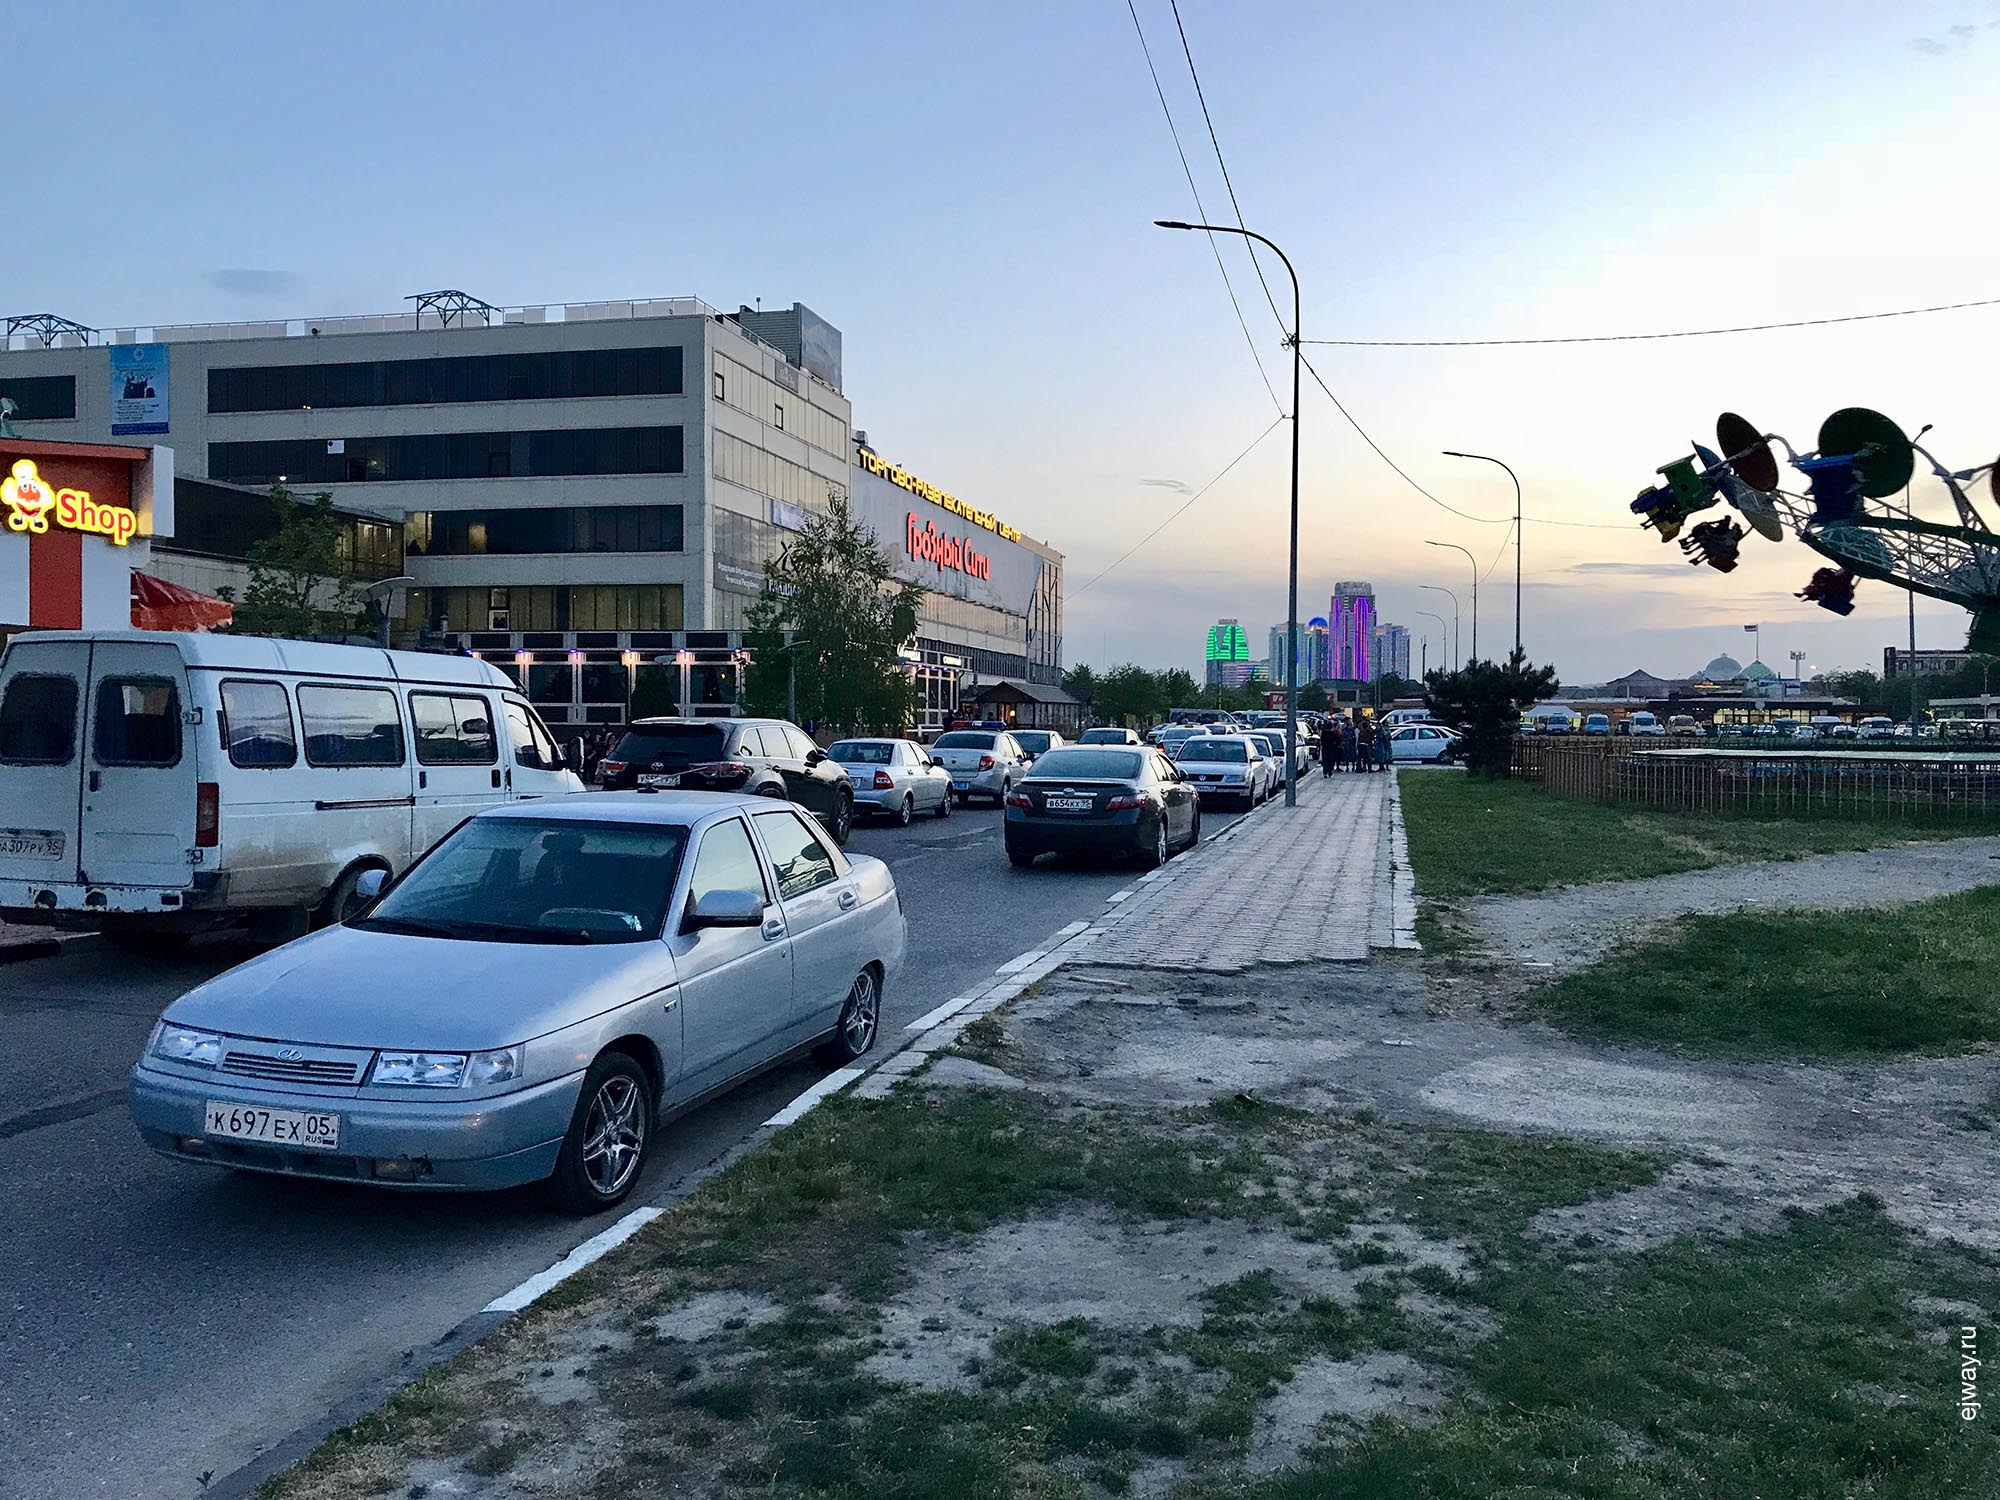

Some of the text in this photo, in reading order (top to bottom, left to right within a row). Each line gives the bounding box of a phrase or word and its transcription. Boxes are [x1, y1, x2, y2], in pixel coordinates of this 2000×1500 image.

[58, 491, 134, 541] Shop
[859, 448, 1022, 544] ТОРГОВО-РАЗВЛЕКАТЕЛЬНЫЙ ЦЕНТР
[963, 537, 991, 582] Сити
[305, 1135, 323, 1144] RUS
[307, 1115, 331, 1136] 05
